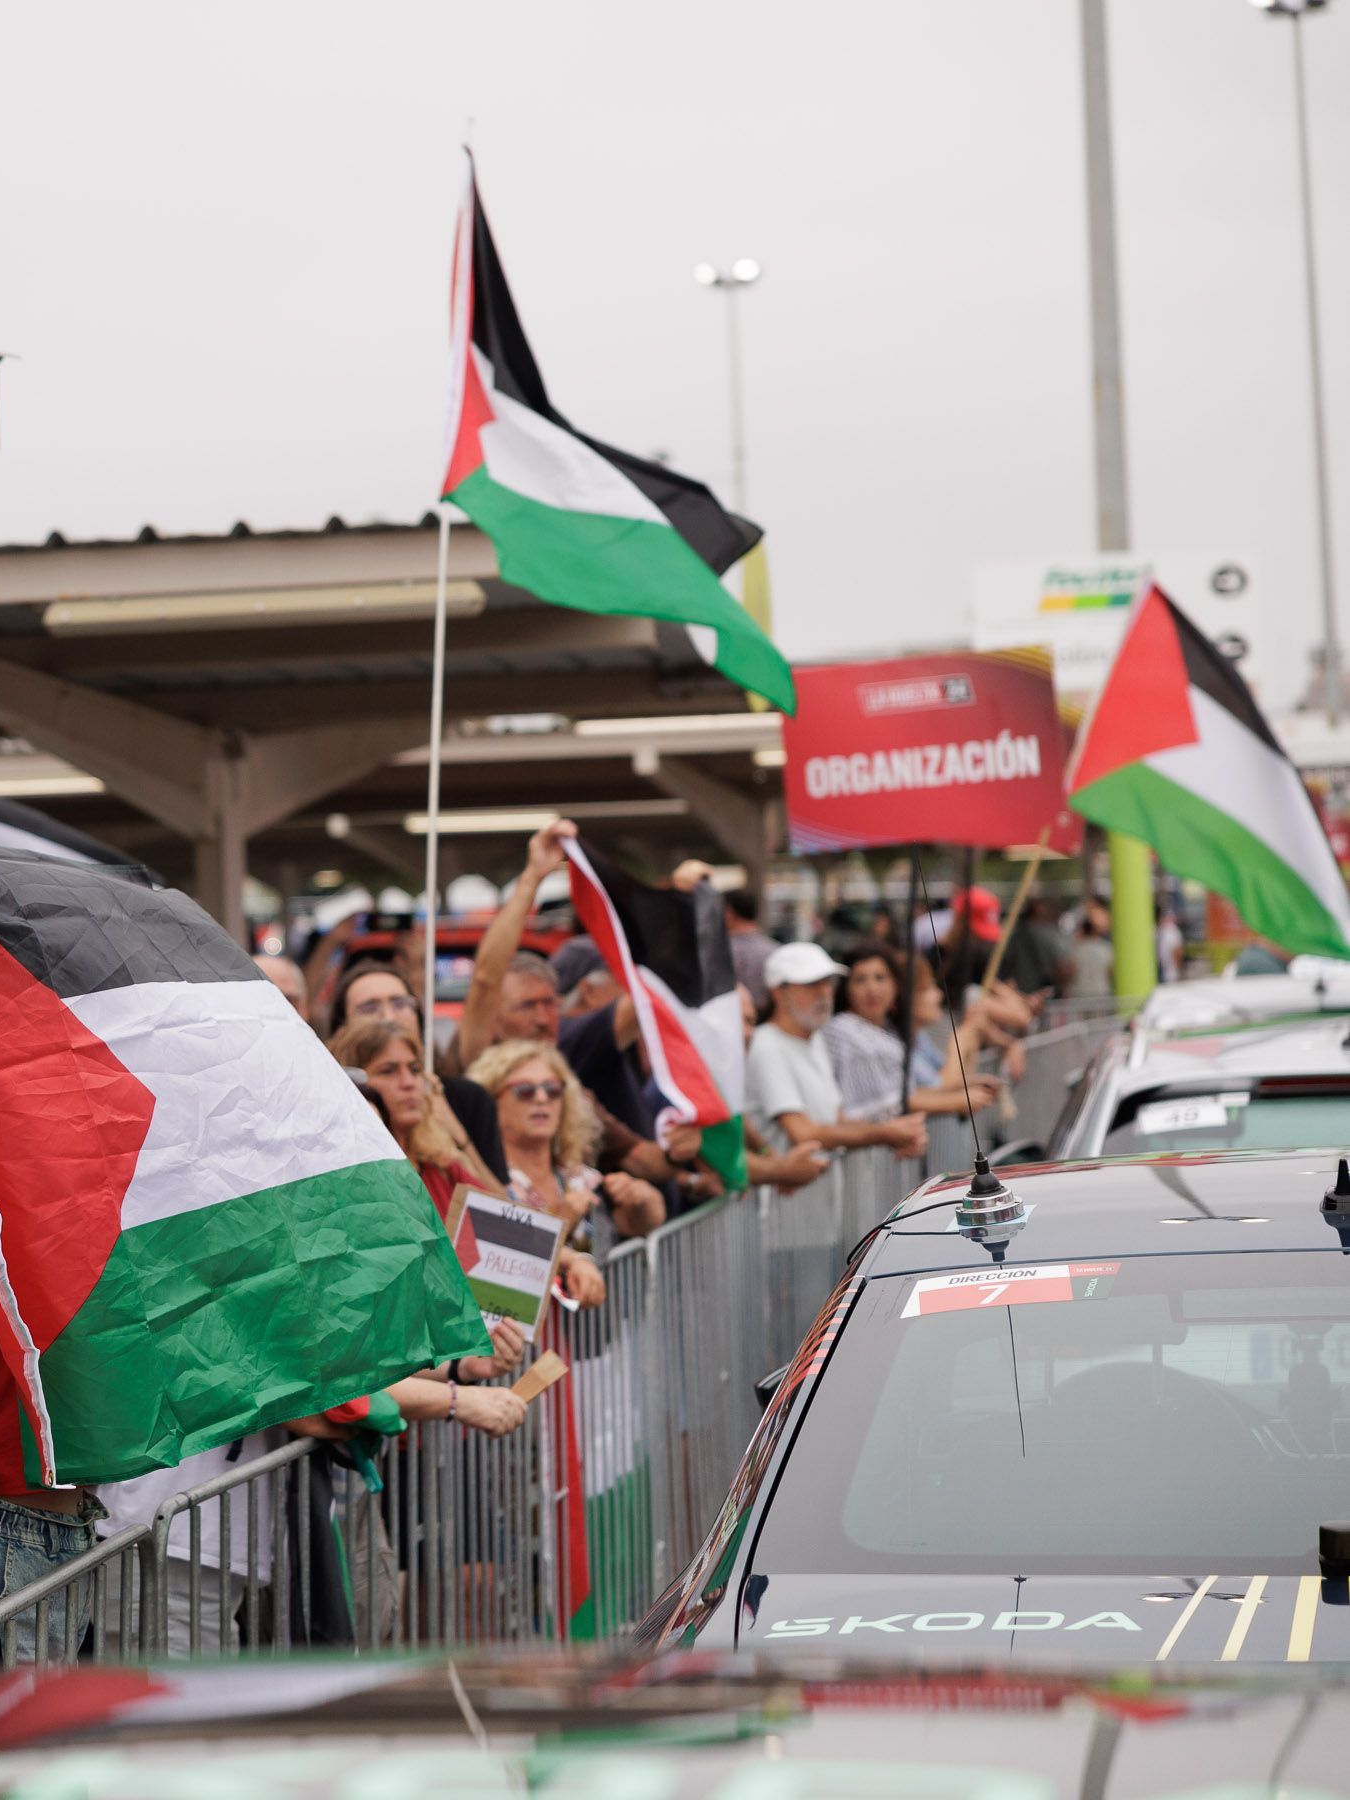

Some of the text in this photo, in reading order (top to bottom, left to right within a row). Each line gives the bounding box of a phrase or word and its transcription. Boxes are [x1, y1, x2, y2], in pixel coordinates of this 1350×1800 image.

[804, 728, 1042, 799] ORGANIZACIÓN
[484, 1251, 547, 1281] PALESTINA
[948, 1269, 1037, 1285] DIRECCIÓN
[978, 1283, 1010, 1305] 7
